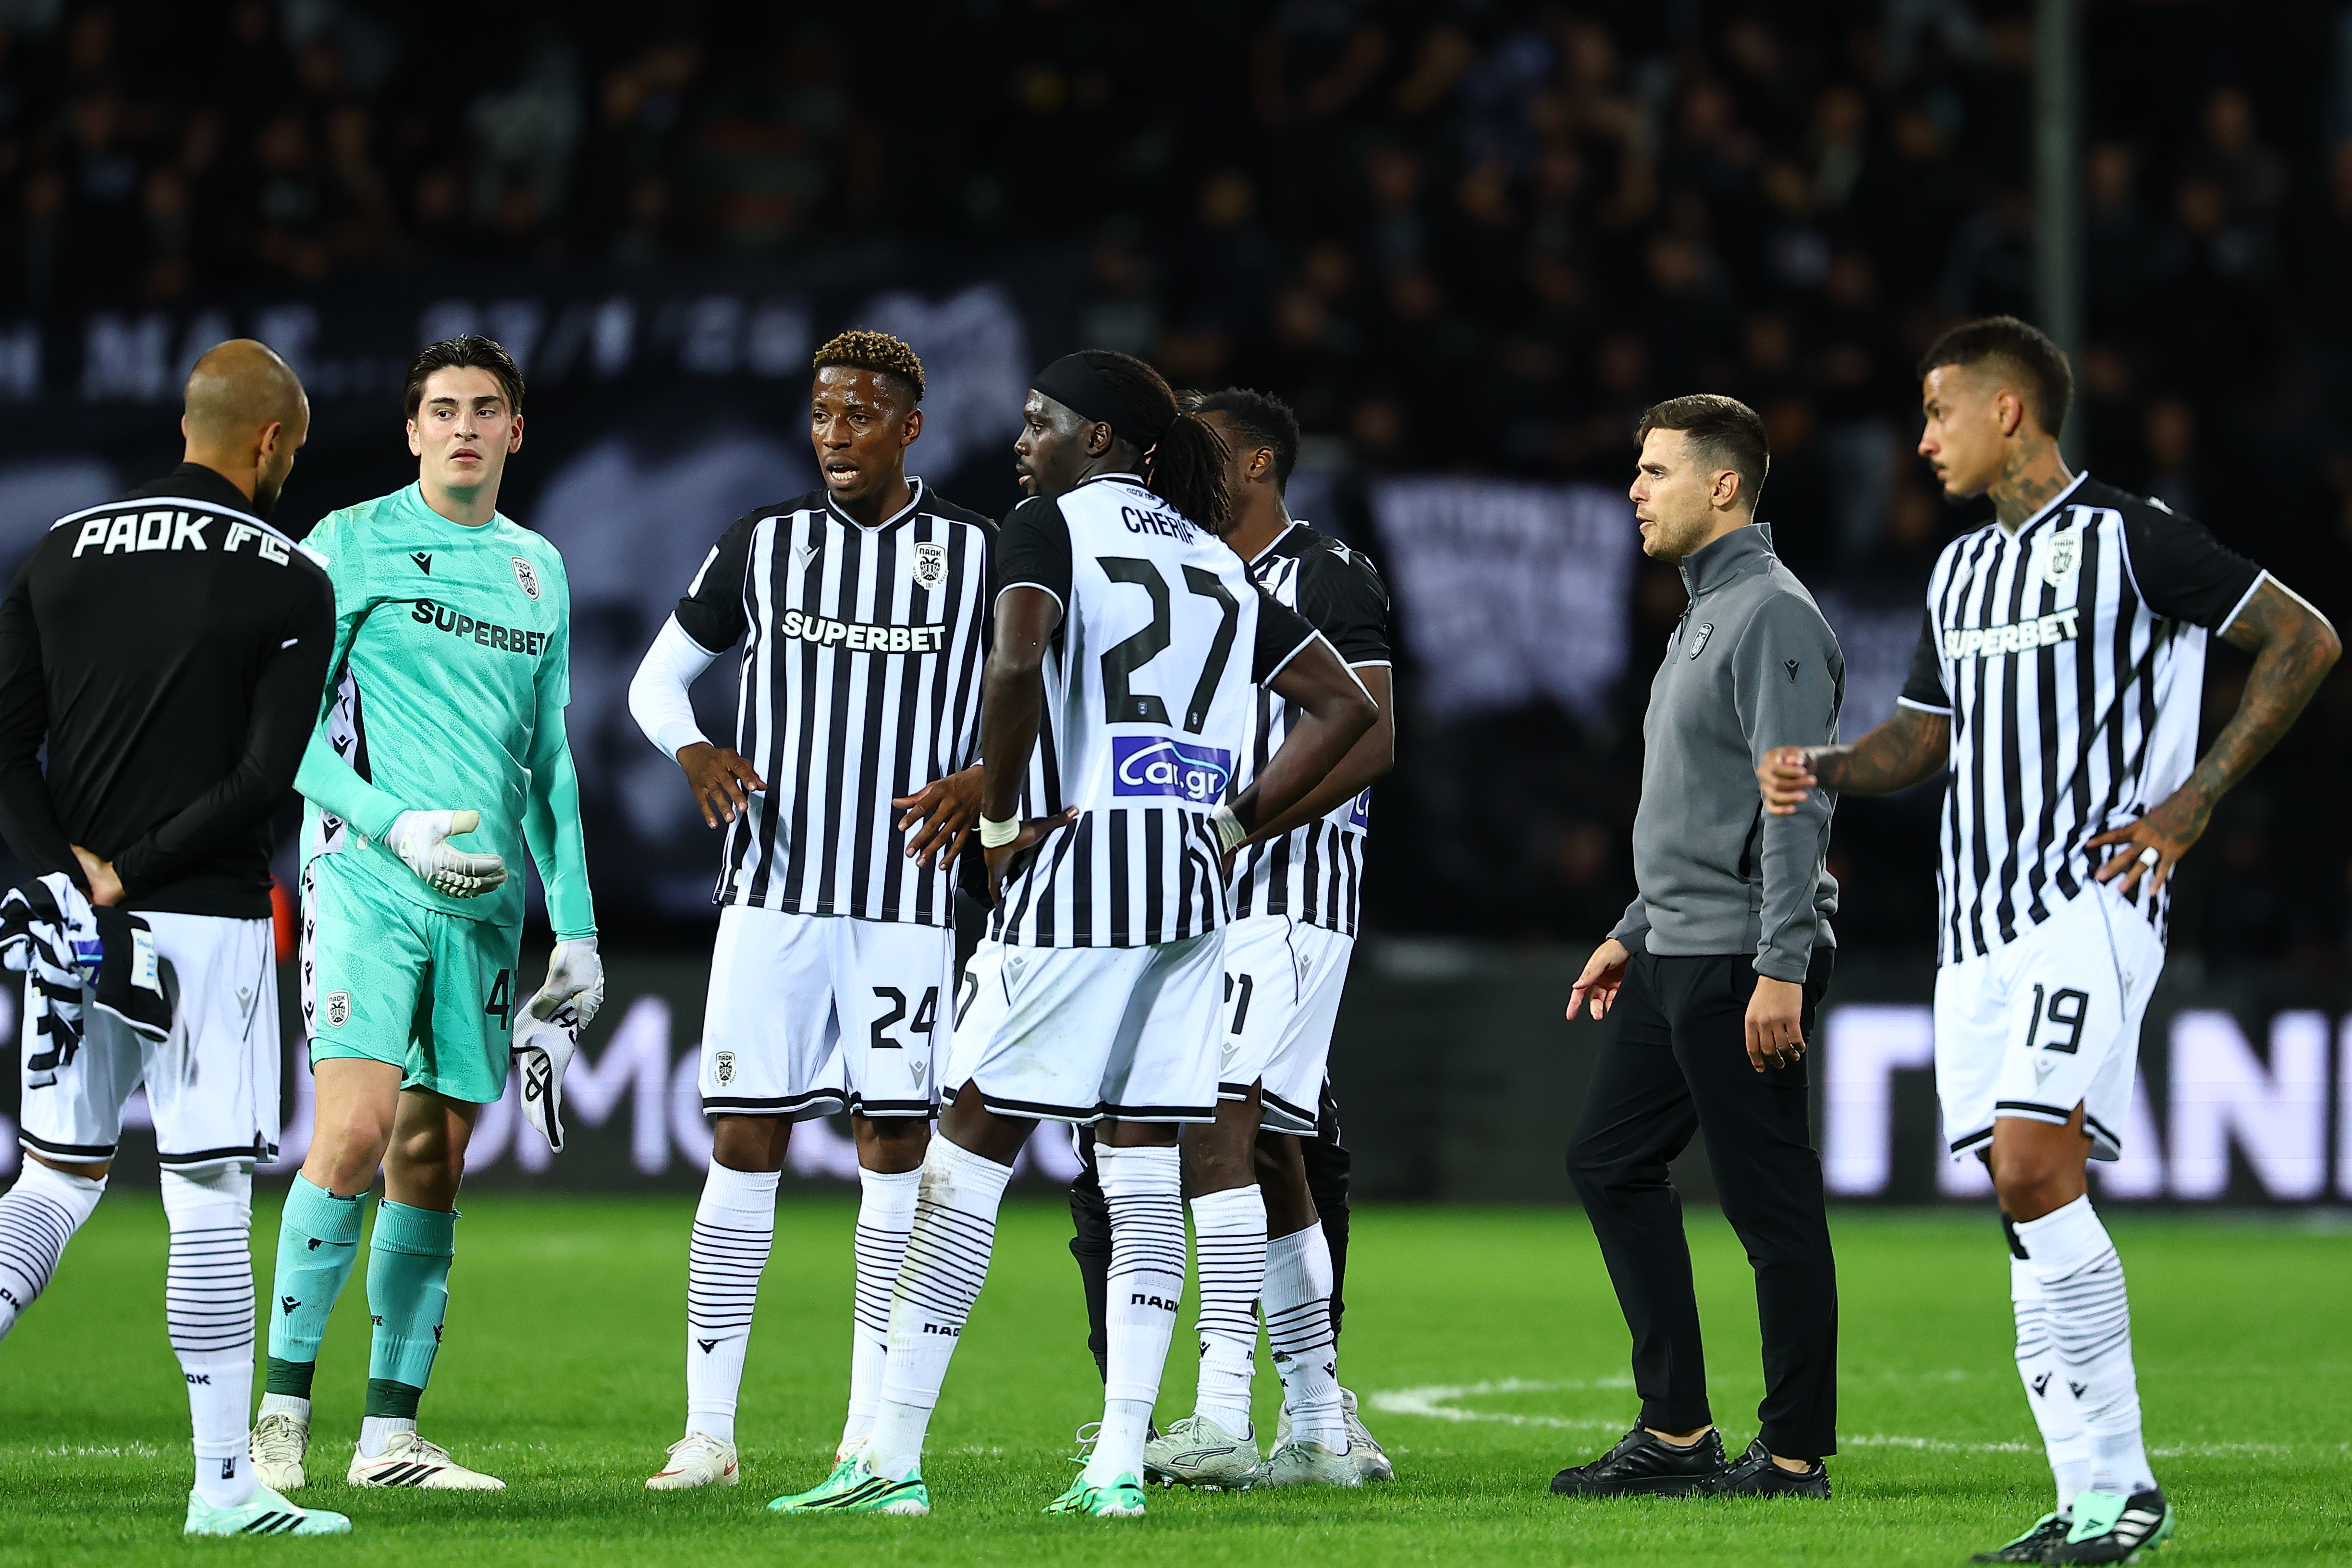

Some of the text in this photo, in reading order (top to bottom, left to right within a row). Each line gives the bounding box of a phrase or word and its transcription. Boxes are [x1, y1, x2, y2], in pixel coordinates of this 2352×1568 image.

[72, 511, 291, 567] PAOK FC
[514, 561, 532, 572] ΠΑΟΚ
[915, 548, 942, 557] ΠΑΟΚ
[412, 600, 545, 657] SUPERBET
[782, 609, 946, 652] SUPERBET
[1095, 556, 1240, 735] 27
[485, 969, 517, 1030] 4
[871, 986, 939, 1049] 24
[2025, 983, 2088, 1054] 19
[923, 1323, 961, 1337] ΠΑΟ
